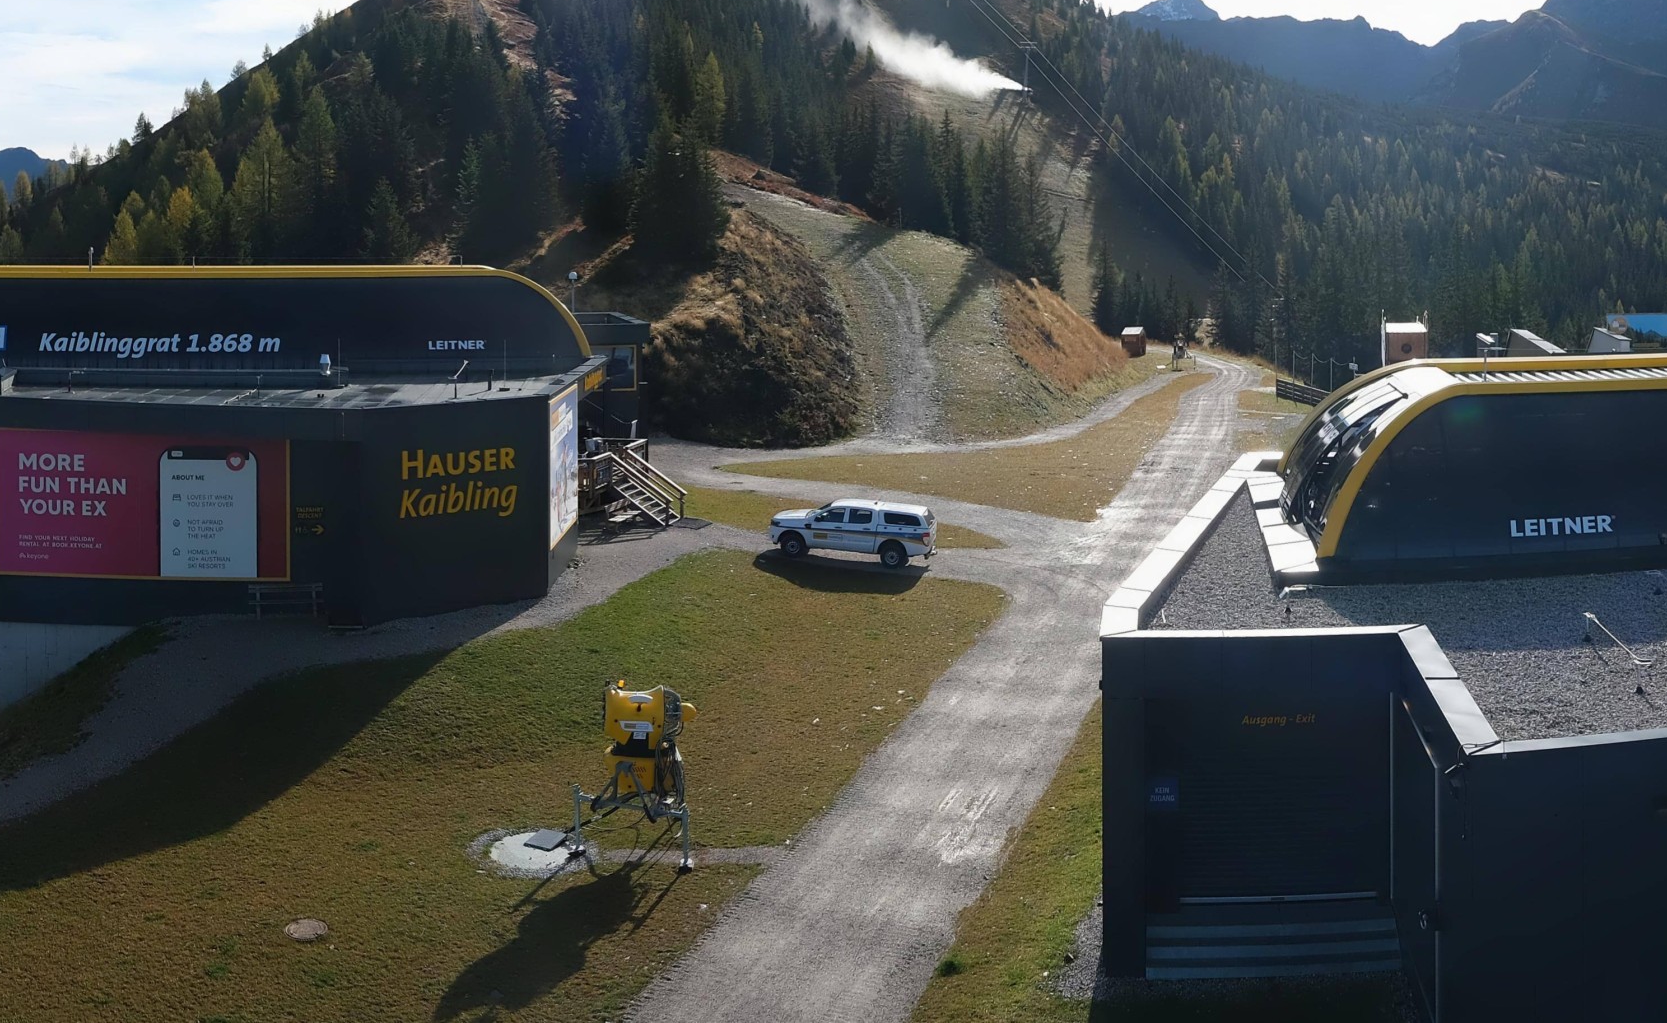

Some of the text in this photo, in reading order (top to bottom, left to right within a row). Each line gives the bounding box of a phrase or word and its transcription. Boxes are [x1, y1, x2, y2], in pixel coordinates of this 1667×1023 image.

[39, 332, 280, 359] Kaiblinggrat 1.868 m
[428, 340, 485, 350] LEITNER
[18, 453, 85, 471] MORE
[401, 447, 516, 480] HAUSER
[18, 476, 126, 495] FUN THAN
[19, 498, 107, 516] YOUR EX
[399, 481, 518, 519] Kaibling
[1510, 515, 1613, 537] LEITNER
[26, 552, 49, 560] keyone
[1241, 714, 1287, 727] Ausgang
[1295, 712, 1316, 723] Exit
[1149, 794, 1175, 802] ZUGANG
[1154, 786, 1170, 794] KEIN
